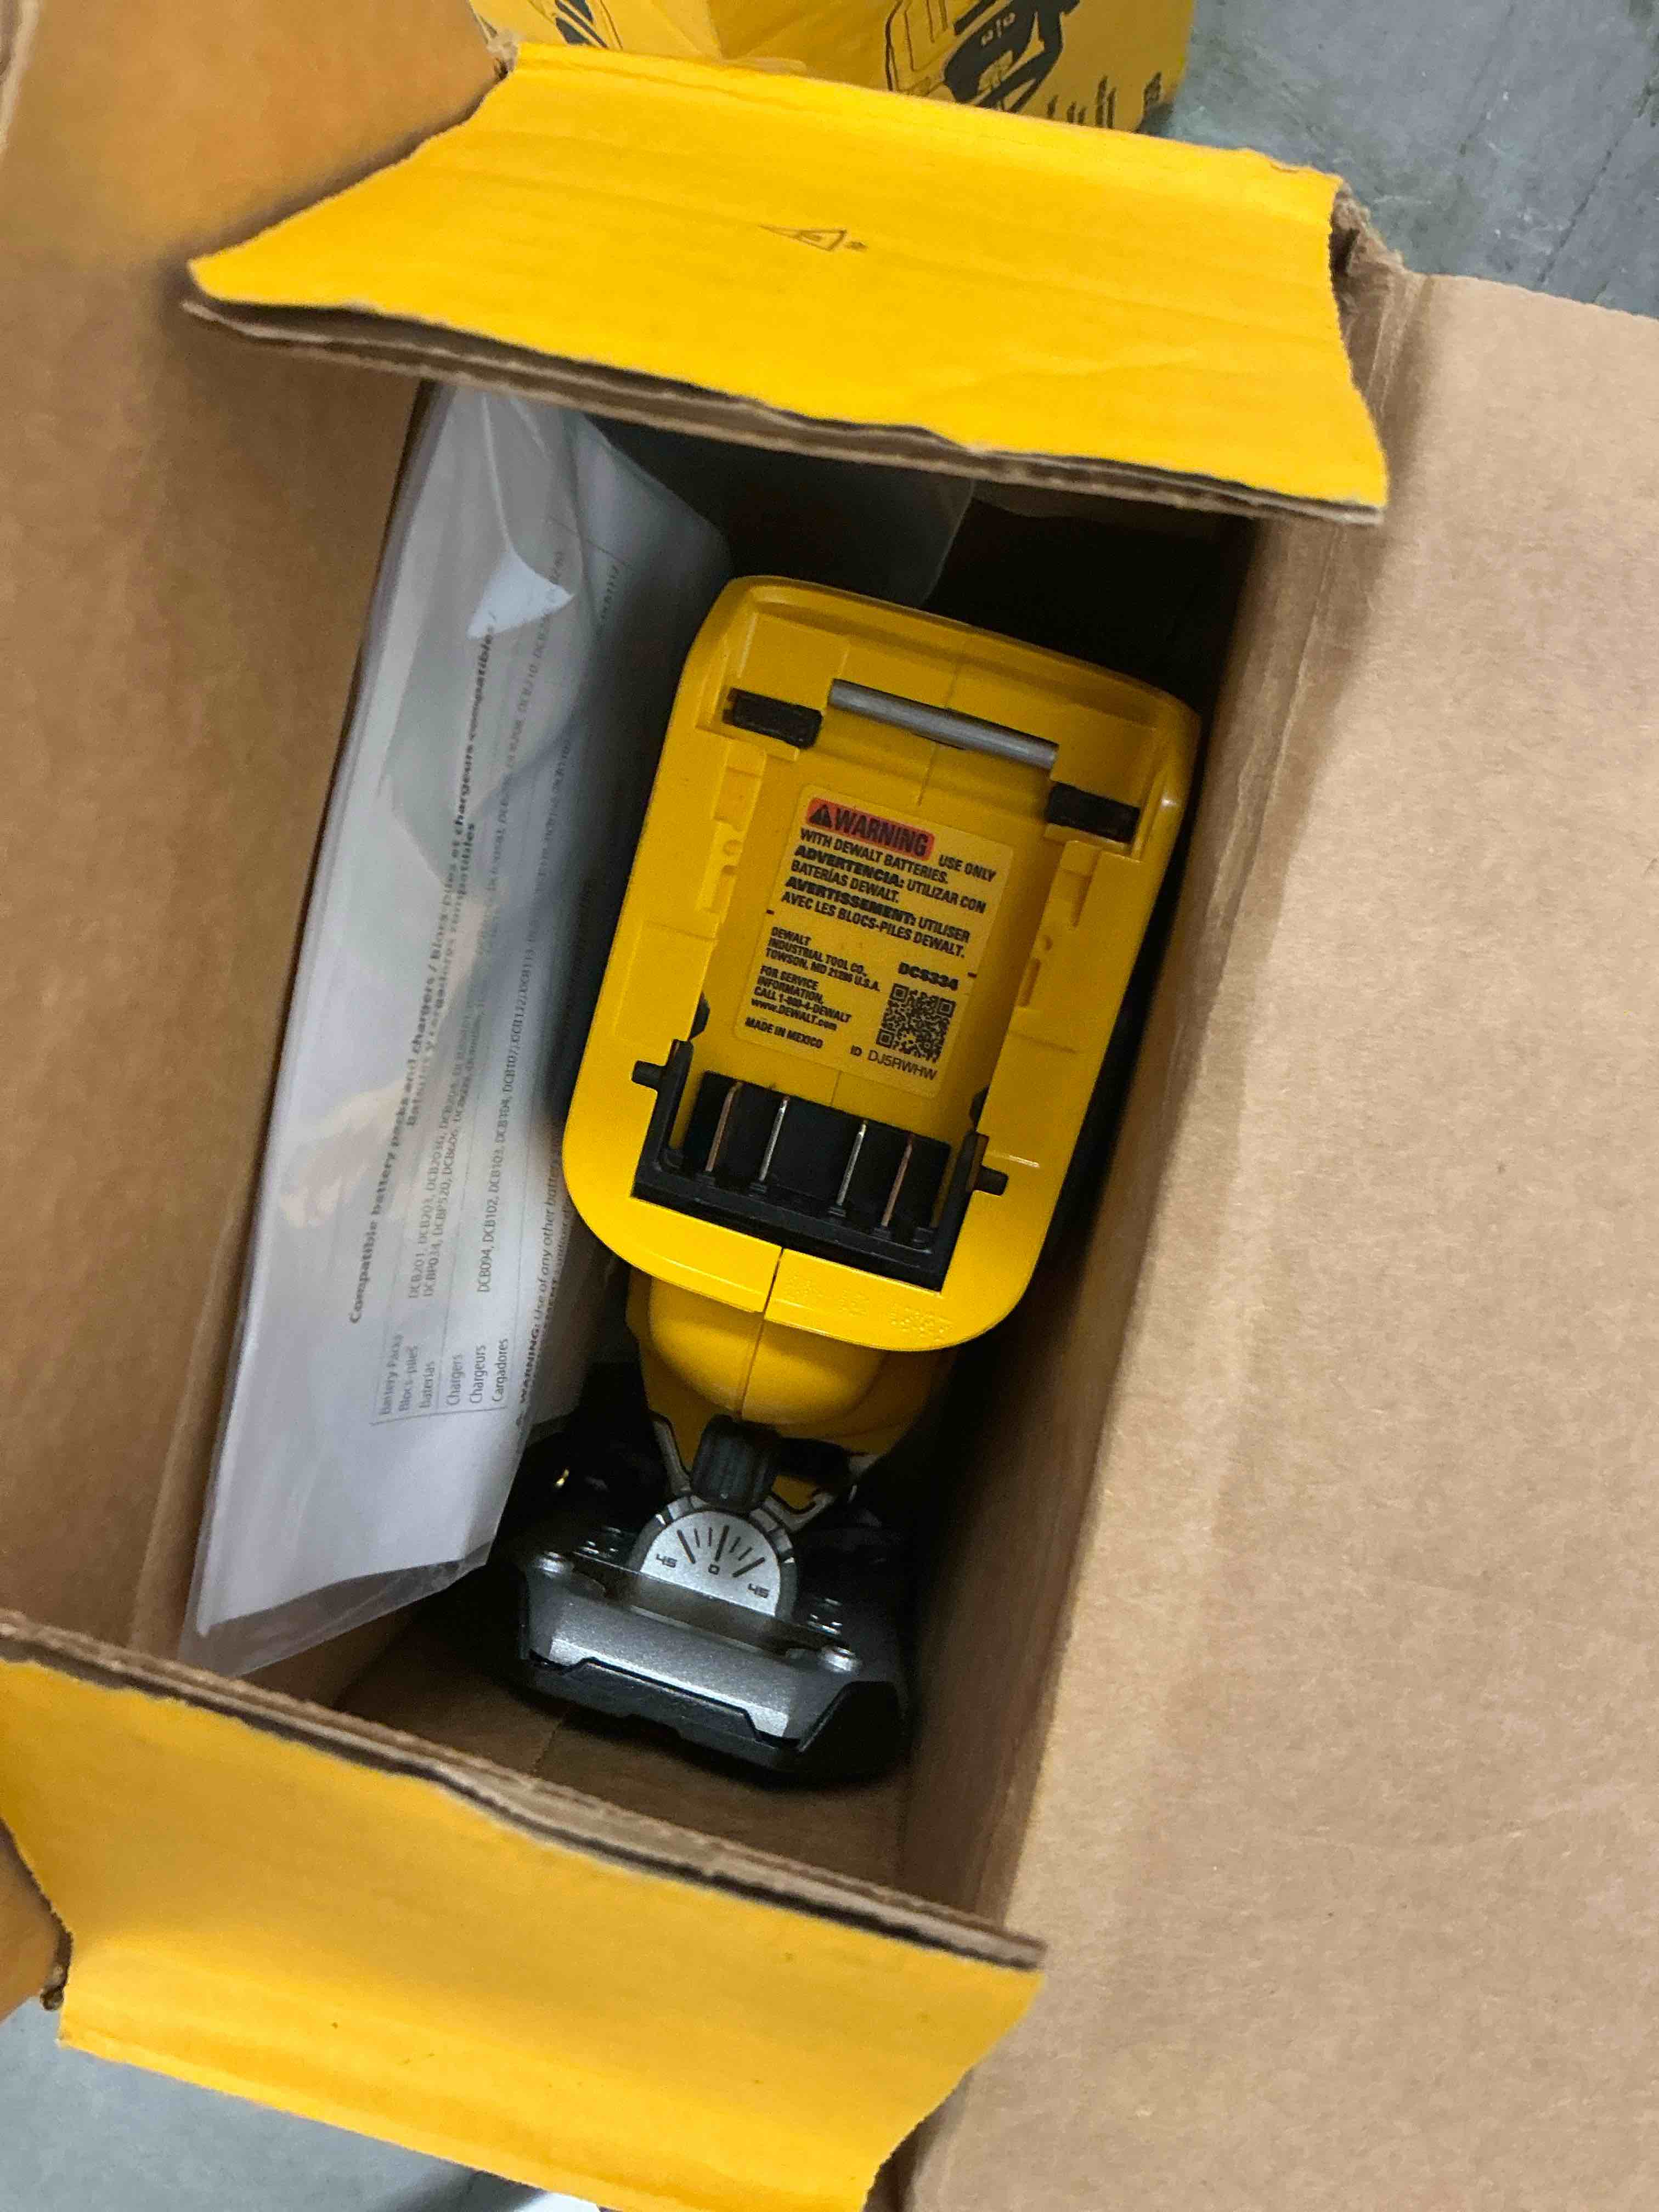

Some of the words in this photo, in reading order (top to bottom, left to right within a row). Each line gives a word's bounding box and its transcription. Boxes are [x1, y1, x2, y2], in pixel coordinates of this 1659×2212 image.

[832, 807, 929, 856] WARNING
[799, 827, 831, 848] WITH
[834, 838, 882, 863] DEWALT
[884, 854, 949, 884] BATTERIES.
[938, 854, 962, 872] USE
[964, 862, 995, 883] ONLY
[792, 856, 848, 887] BATERÍAS
[850, 877, 900, 903] DEWALT.
[795, 844, 904, 888] ADVERTENCIA:
[907, 878, 959, 905] UTILIZAR
[960, 895, 985, 913] CON
[782, 890, 812, 910] AVEC
[815, 900, 836, 917] LES
[838, 907, 912, 940] BLOCS-PILES
[914, 931, 966, 957] DEWALT.
[786, 875, 916, 925] AVERTISSEMENT:
[918, 916, 969, 943] UTILISER
[769, 937, 822, 961] INDUSTRIAL
[826, 954, 848, 969] TOOL
[772, 926, 810, 946] DEWALT
[754, 985, 776, 1000] CALL
[760, 964, 777, 978] FOR
[781, 970, 817, 990] SERVICE
[811, 961, 826, 974] MD
[854, 975, 882, 991] U.S.A.
[746, 1017, 773, 1033] MADE
[775, 1025, 785, 1037] IN
[787, 1029, 822, 1048] MEXICO
[751, 996, 837, 1030] www.DEWALT.com
[851, 1045, 862, 1057] ID
[349, 1221, 379, 1323] Compatible
[371, 1152, 396, 1215] battery
[482, 1197, 500, 1242] DCB102,
[541, 1210, 555, 1246] other
[477, 1246, 494, 1293] DCB094,
[538, 1276, 548, 1290] of
[541, 1249, 553, 1276] any
[534, 1295, 545, 1320] Use
[447, 1353, 465, 1406] Chargers
[470, 1345, 488, 1403] Chargeurs
[492, 1339, 508, 1402] Cargadores
[521, 1324, 540, 1403] WARNING:
[656, 1553, 678, 1568] 45
[748, 1583, 770, 1599] 45
